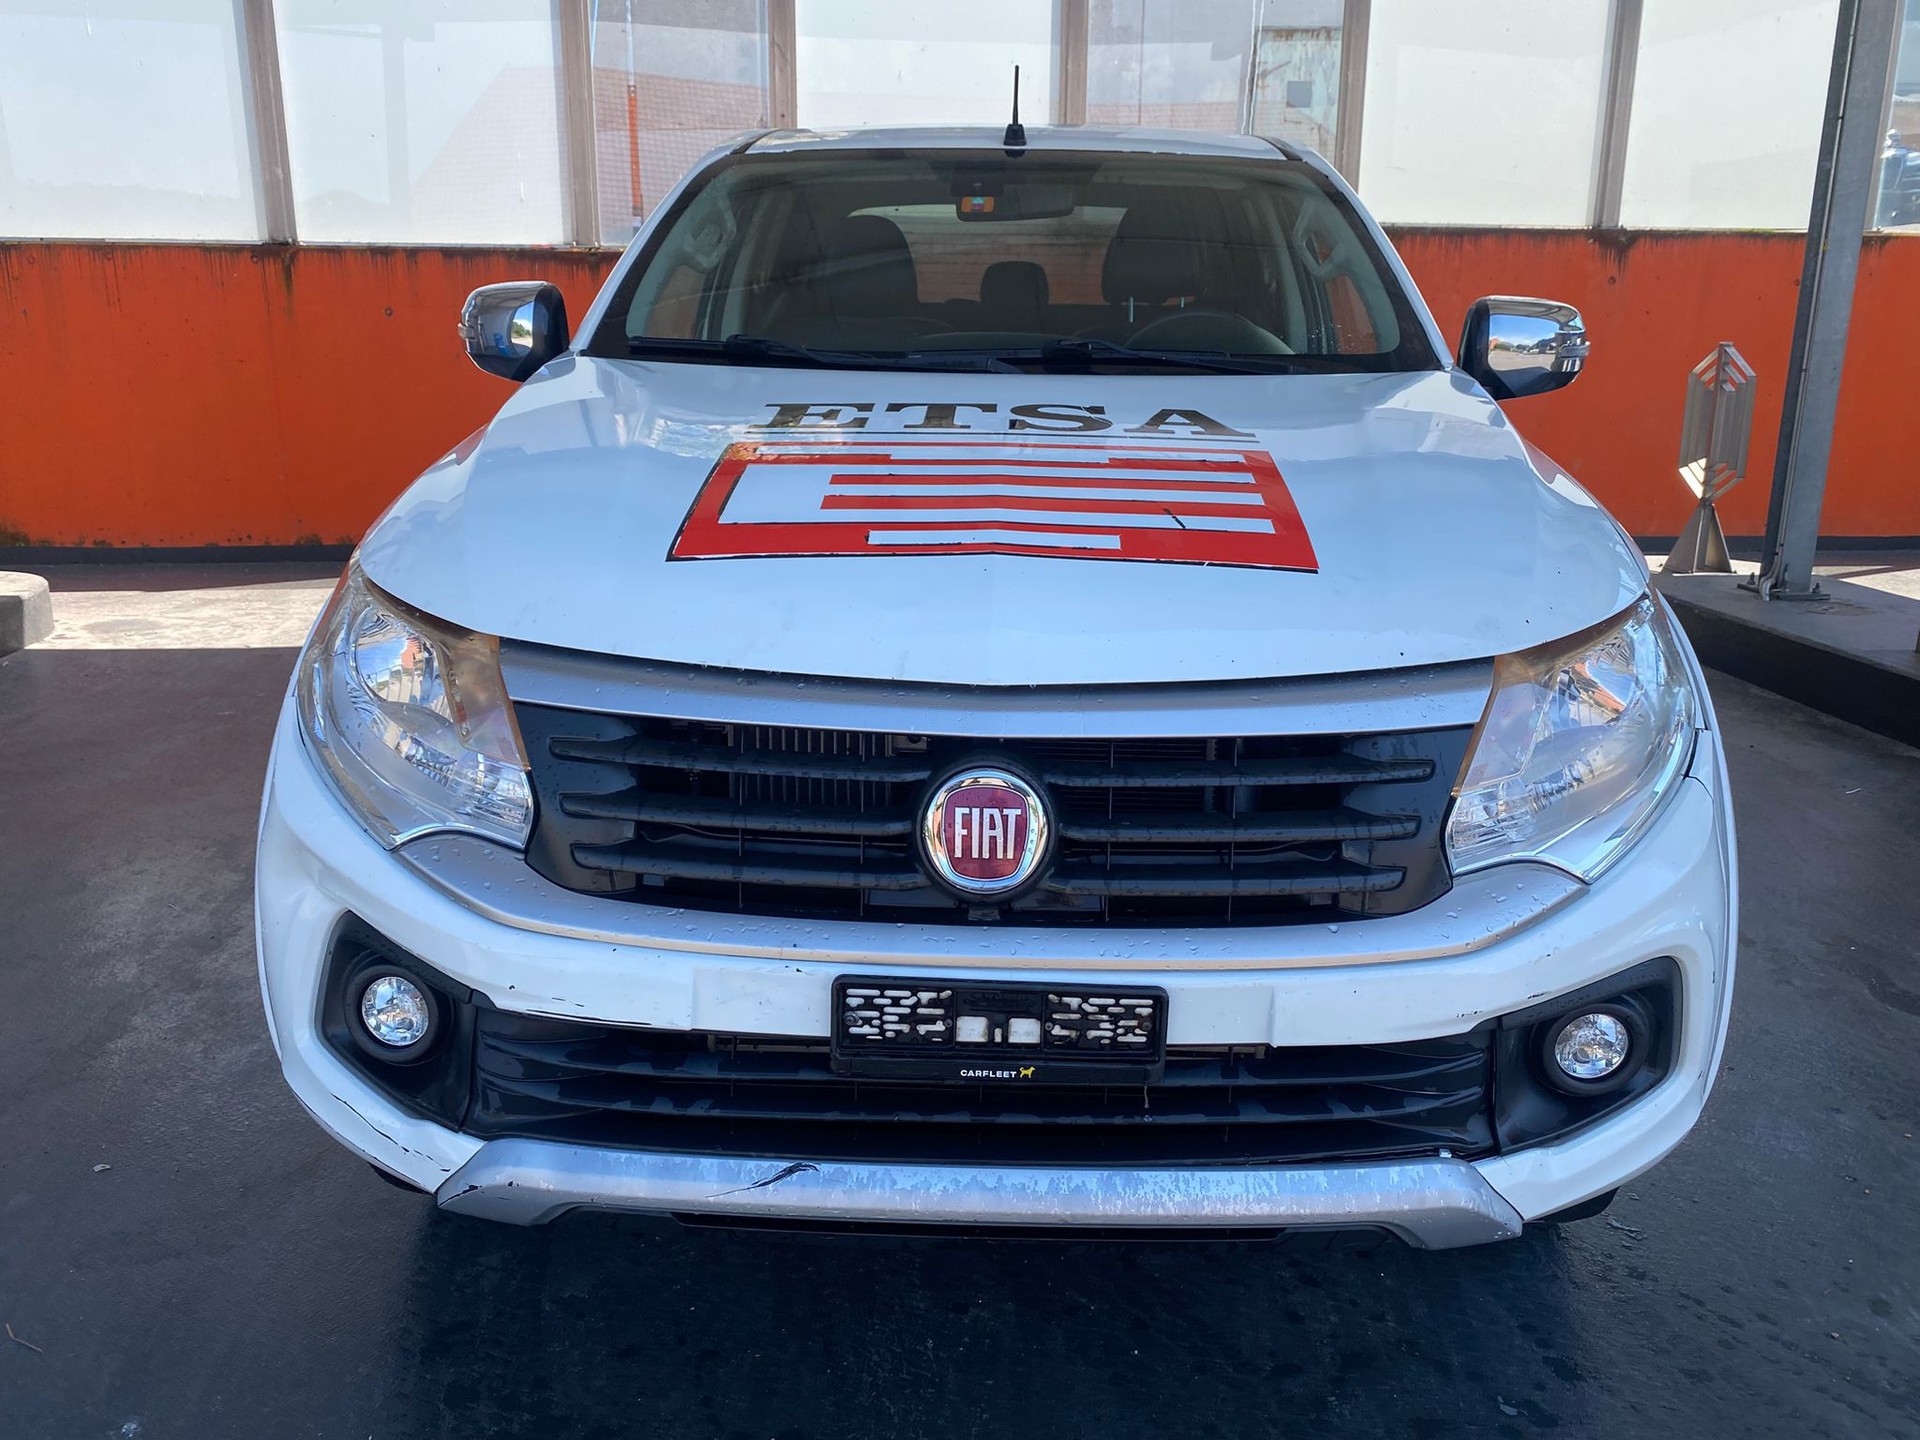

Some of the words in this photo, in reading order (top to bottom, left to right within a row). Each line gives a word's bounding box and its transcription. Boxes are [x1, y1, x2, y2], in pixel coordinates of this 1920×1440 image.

[748, 403, 1256, 436] ETSA
[954, 807, 1021, 859] FIAT
[960, 1069, 1017, 1078] CARFLEET
